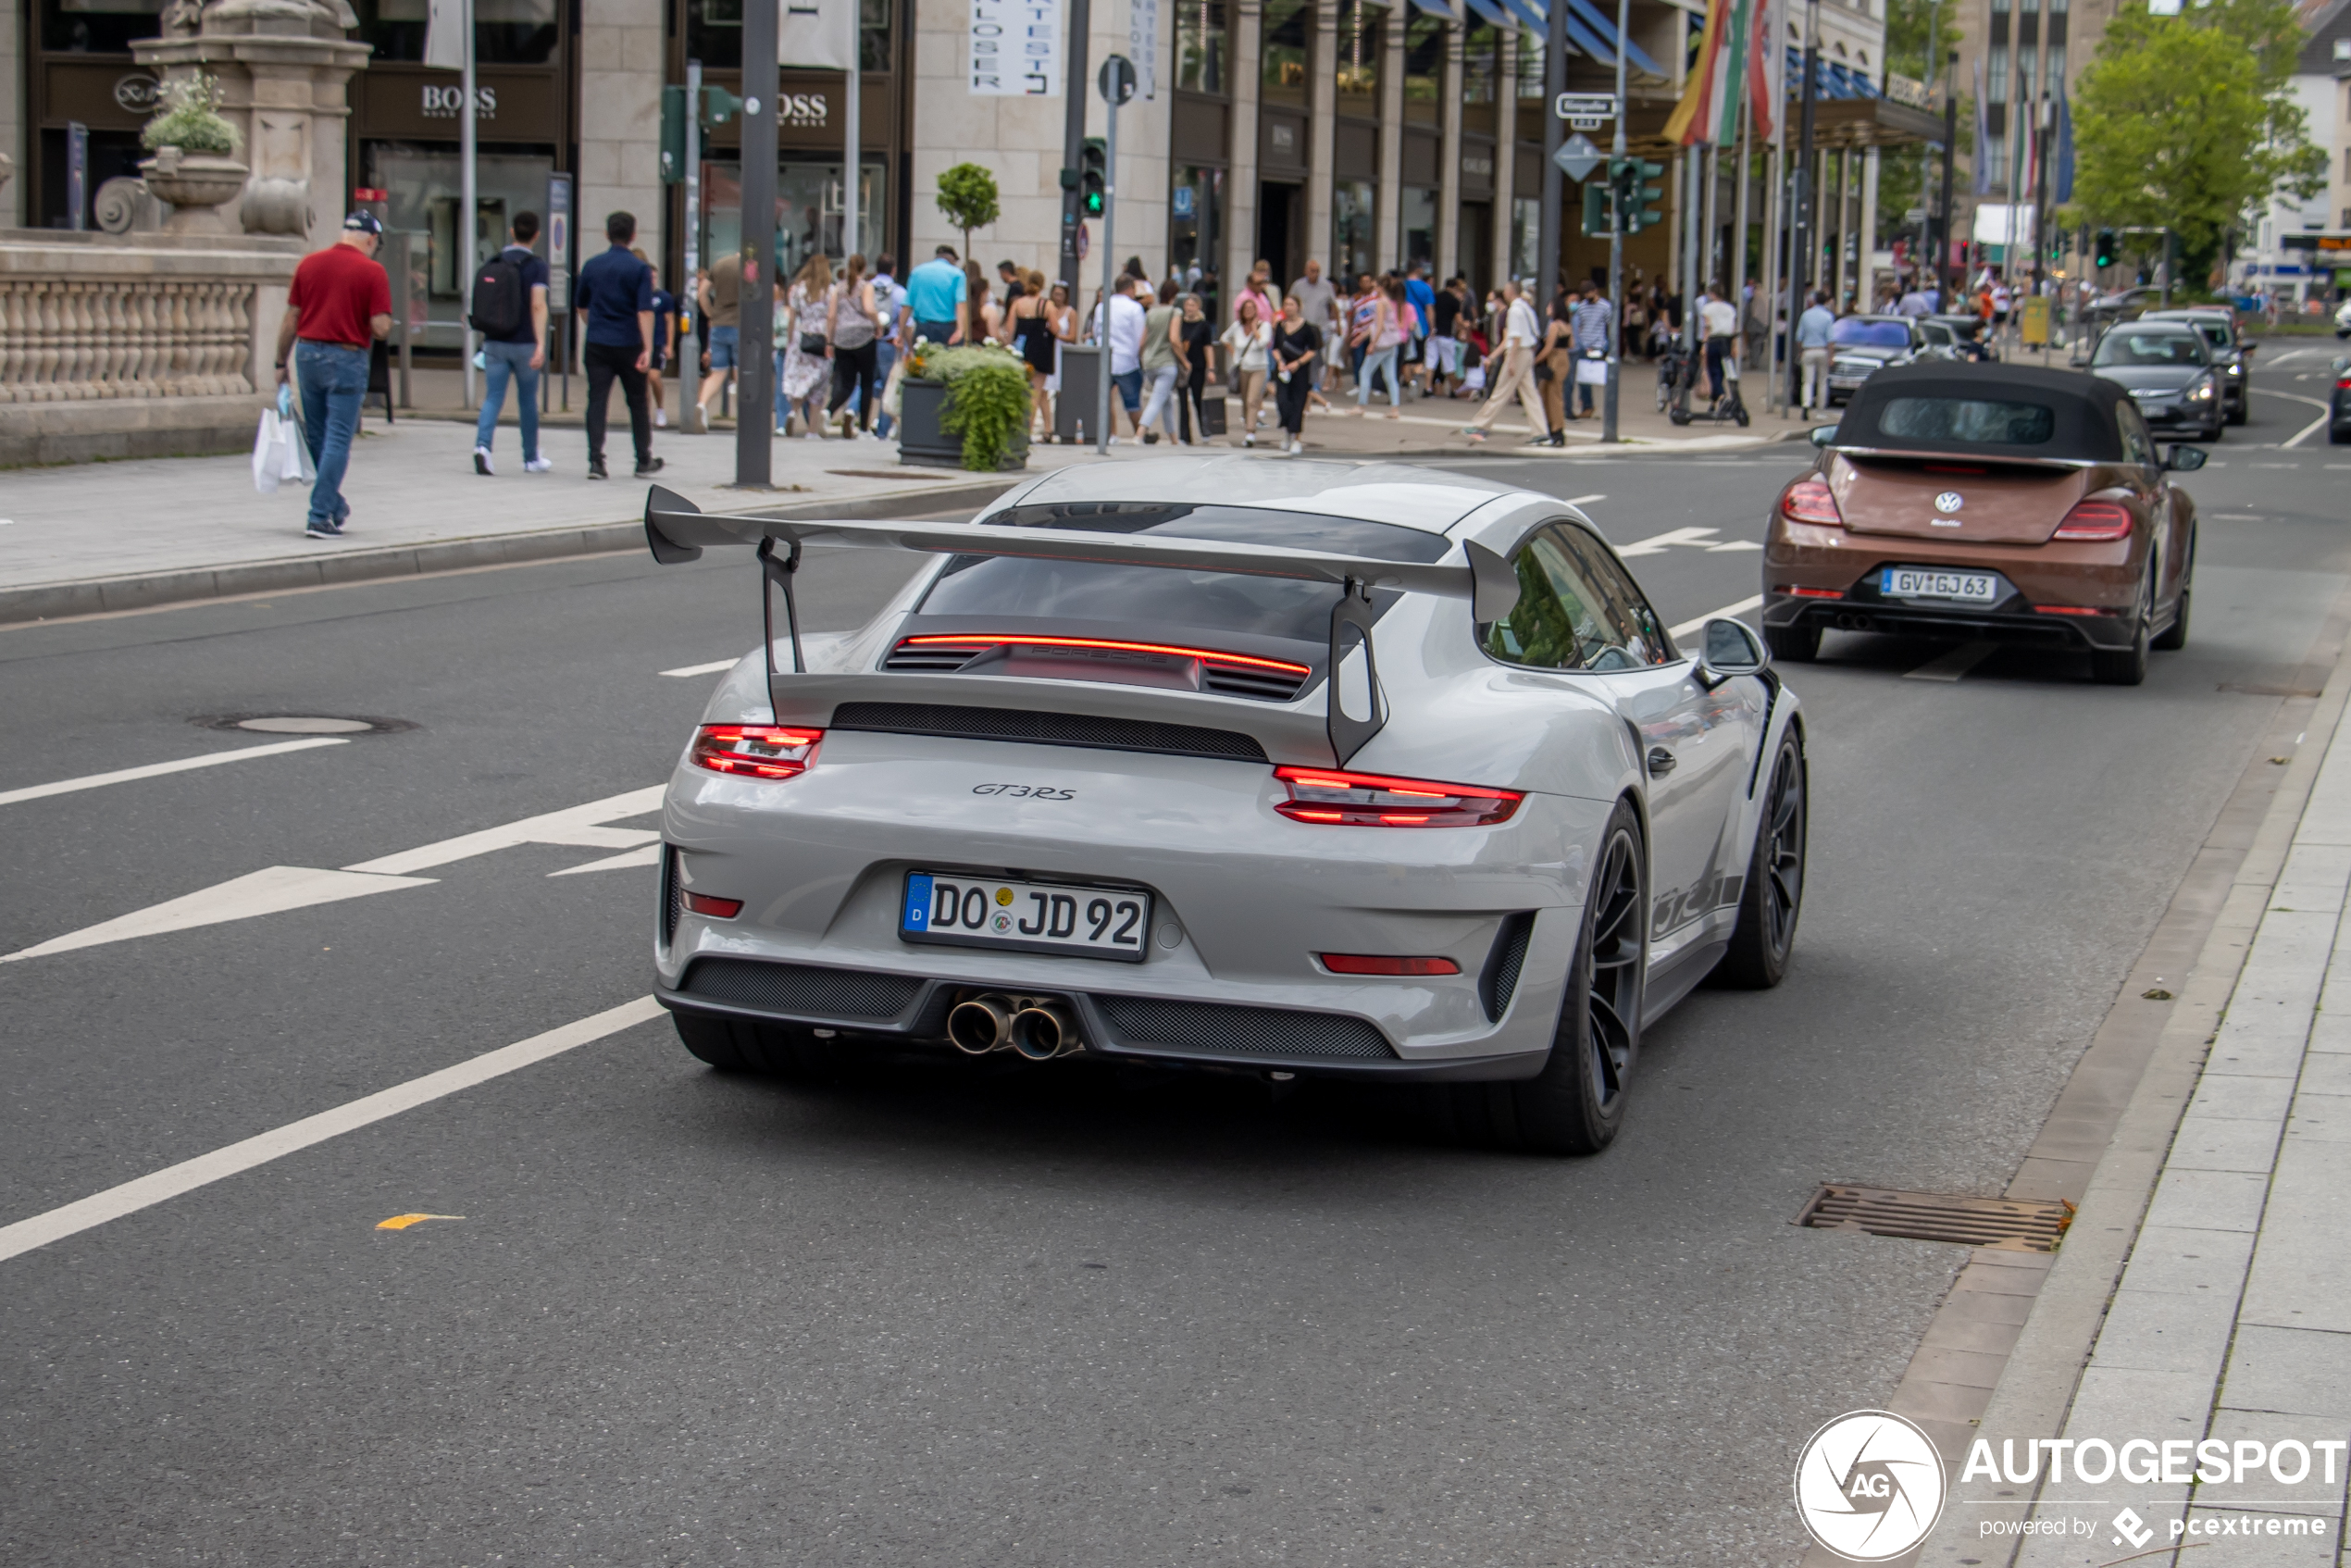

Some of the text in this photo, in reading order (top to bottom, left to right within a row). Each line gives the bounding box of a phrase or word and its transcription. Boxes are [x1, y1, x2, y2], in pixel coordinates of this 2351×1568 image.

[973, 0, 1002, 88] LOSER
[777, 93, 827, 119] OSS
[1899, 574, 1924, 591] GV
[1936, 576, 1960, 593] GJ
[1964, 578, 1987, 595] 63
[1032, 646, 1168, 664] PORSCHE
[912, 908, 922, 921] D
[931, 883, 1140, 944] DO JD 92
